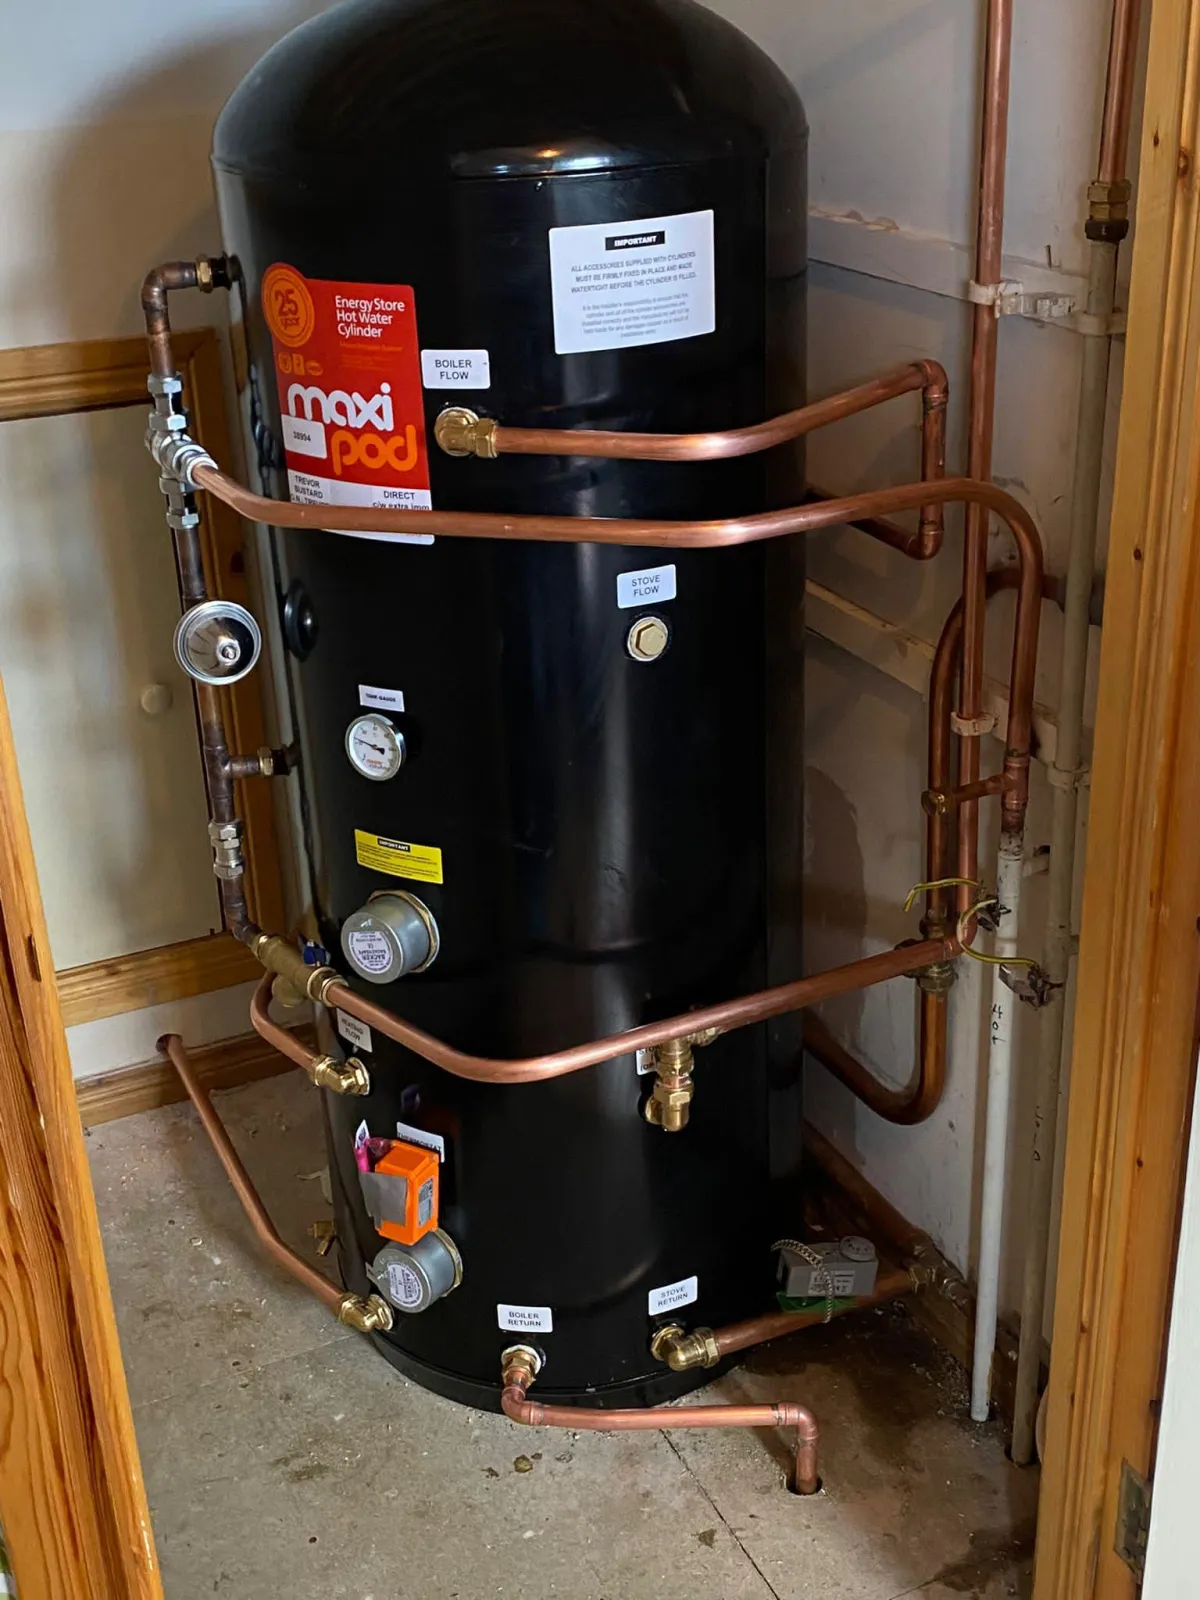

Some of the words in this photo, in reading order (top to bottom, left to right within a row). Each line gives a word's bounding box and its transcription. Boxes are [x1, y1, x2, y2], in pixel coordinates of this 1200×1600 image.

[614, 235, 657, 247] IMPORTANT
[571, 264, 582, 272] ALL
[583, 261, 625, 271] ACCESSORIES
[625, 257, 653, 267] SUPPLIED
[668, 251, 696, 261] CYLINDERS
[576, 274, 592, 282] MUST
[602, 271, 623, 280] FIRMLY
[624, 269, 640, 277] FIXED
[648, 266, 665, 274] PLACE
[678, 262, 692, 270] MADE
[571, 284, 608, 293] WATERTIGHT
[609, 281, 632, 290] BEFORE
[645, 275, 671, 285] CYLINDER
[274, 288, 298, 317] 25
[335, 295, 373, 313] Energy
[374, 298, 405, 312] Store
[336, 309, 357, 323] Hot
[359, 312, 393, 325] Water
[338, 323, 383, 339] Cylinder
[435, 359, 472, 369] BOILER
[440, 371, 469, 380] FLOW
[287, 382, 394, 432] maxi
[331, 424, 418, 476] pod
[295, 475, 320, 488] TREVOR
[294, 485, 323, 499] BUSTARD
[383, 491, 415, 500] DIRECT
[632, 575, 661, 587] STOVE
[634, 585, 659, 597] FLOW
[379, 840, 409, 851] IMPORTANT
[661, 1285, 685, 1298] STOVE
[658, 1292, 688, 1307] RETURN
[509, 1311, 539, 1319] BOILER
